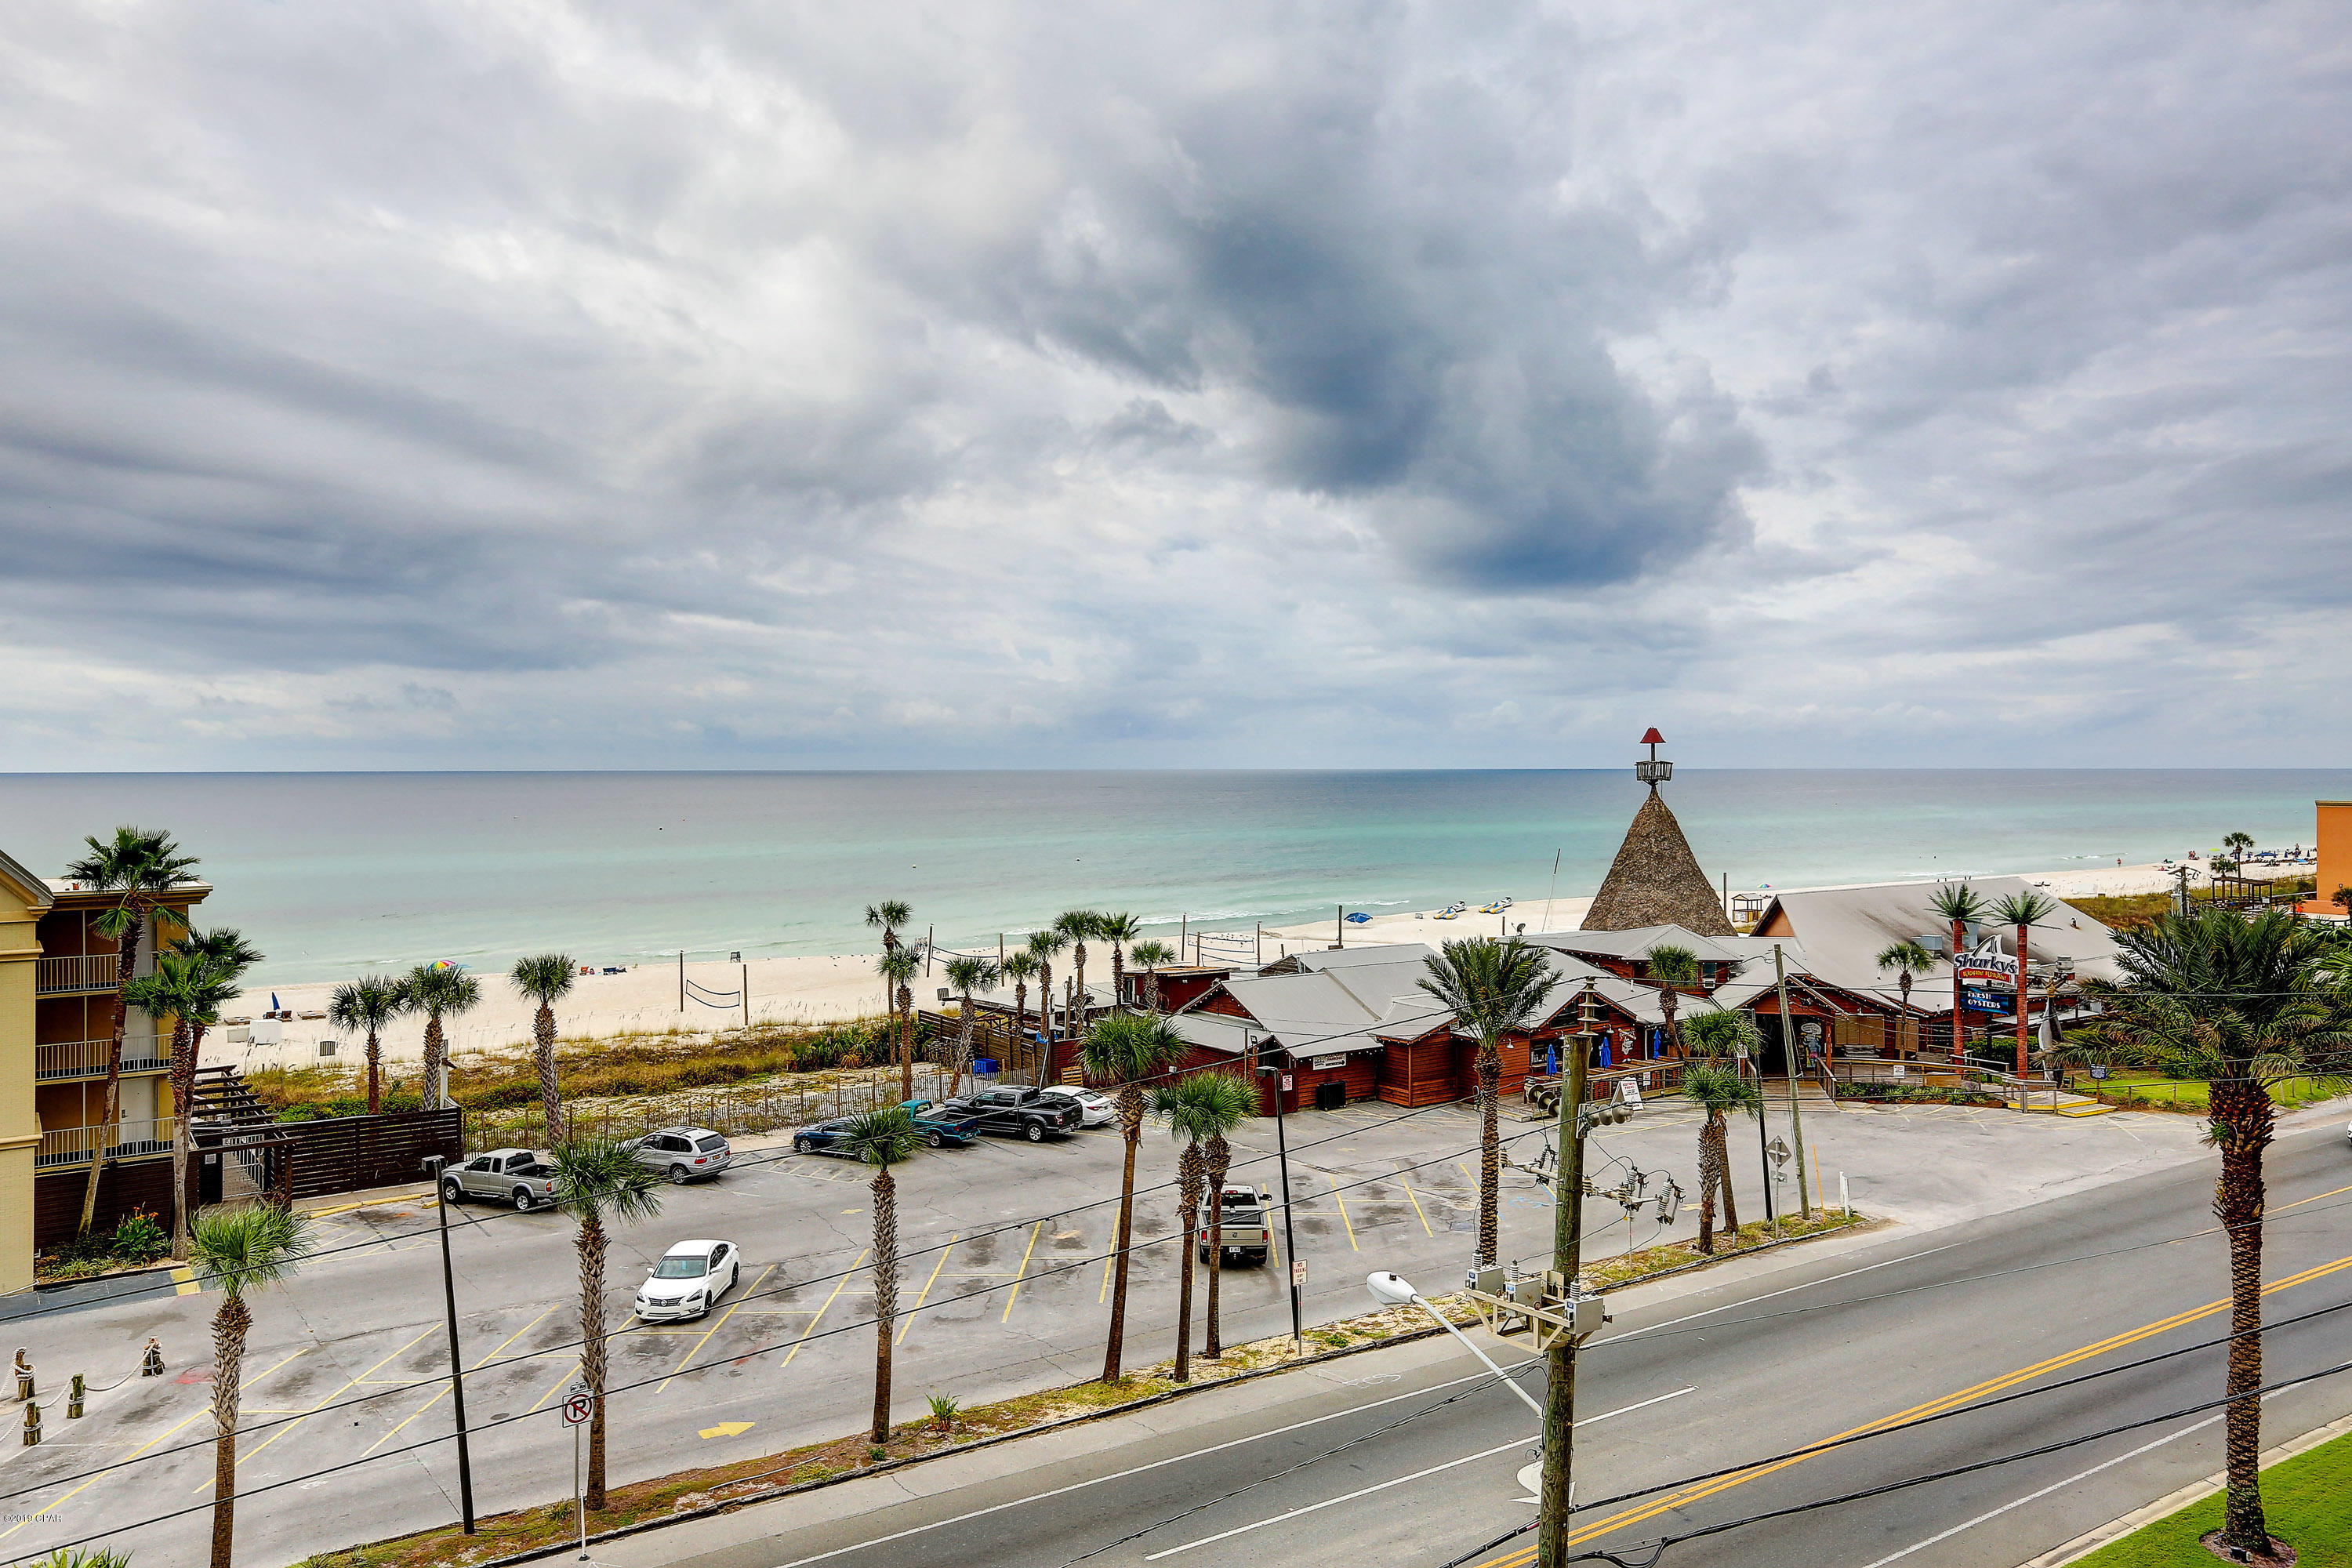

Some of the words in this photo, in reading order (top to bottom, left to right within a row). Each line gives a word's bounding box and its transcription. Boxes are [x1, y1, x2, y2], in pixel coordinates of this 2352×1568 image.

[1955, 953, 2018, 974] Sharky's
[1968, 991, 1991, 1000] FRESH
[1968, 999, 2001, 1009] OYSTERS
